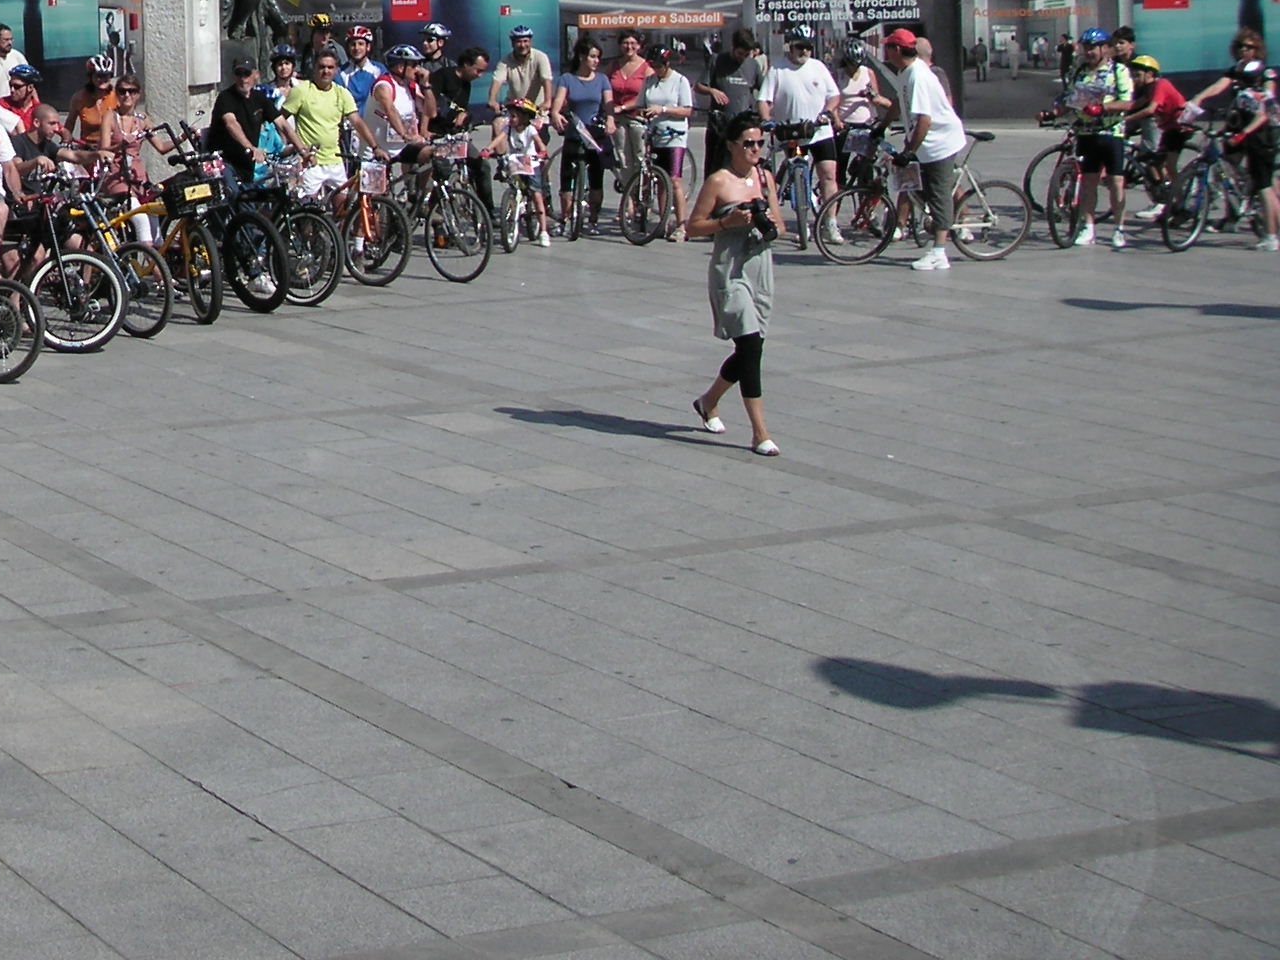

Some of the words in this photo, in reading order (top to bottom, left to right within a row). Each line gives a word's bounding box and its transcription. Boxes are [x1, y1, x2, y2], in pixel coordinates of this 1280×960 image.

[758, 1, 765, 10] 5
[582, 14, 598, 25] Un
[601, 14, 635, 25] metro
[637, 15, 657, 26] per
[659, 15, 667, 24] a
[669, 12, 720, 24] Sabadell
[756, 12, 770, 22] de
[774, 11, 784, 22] la
[787, 10, 854, 22] Generalitat
[857, 11, 864, 20] a
[867, 8, 920, 20] Sabadell
